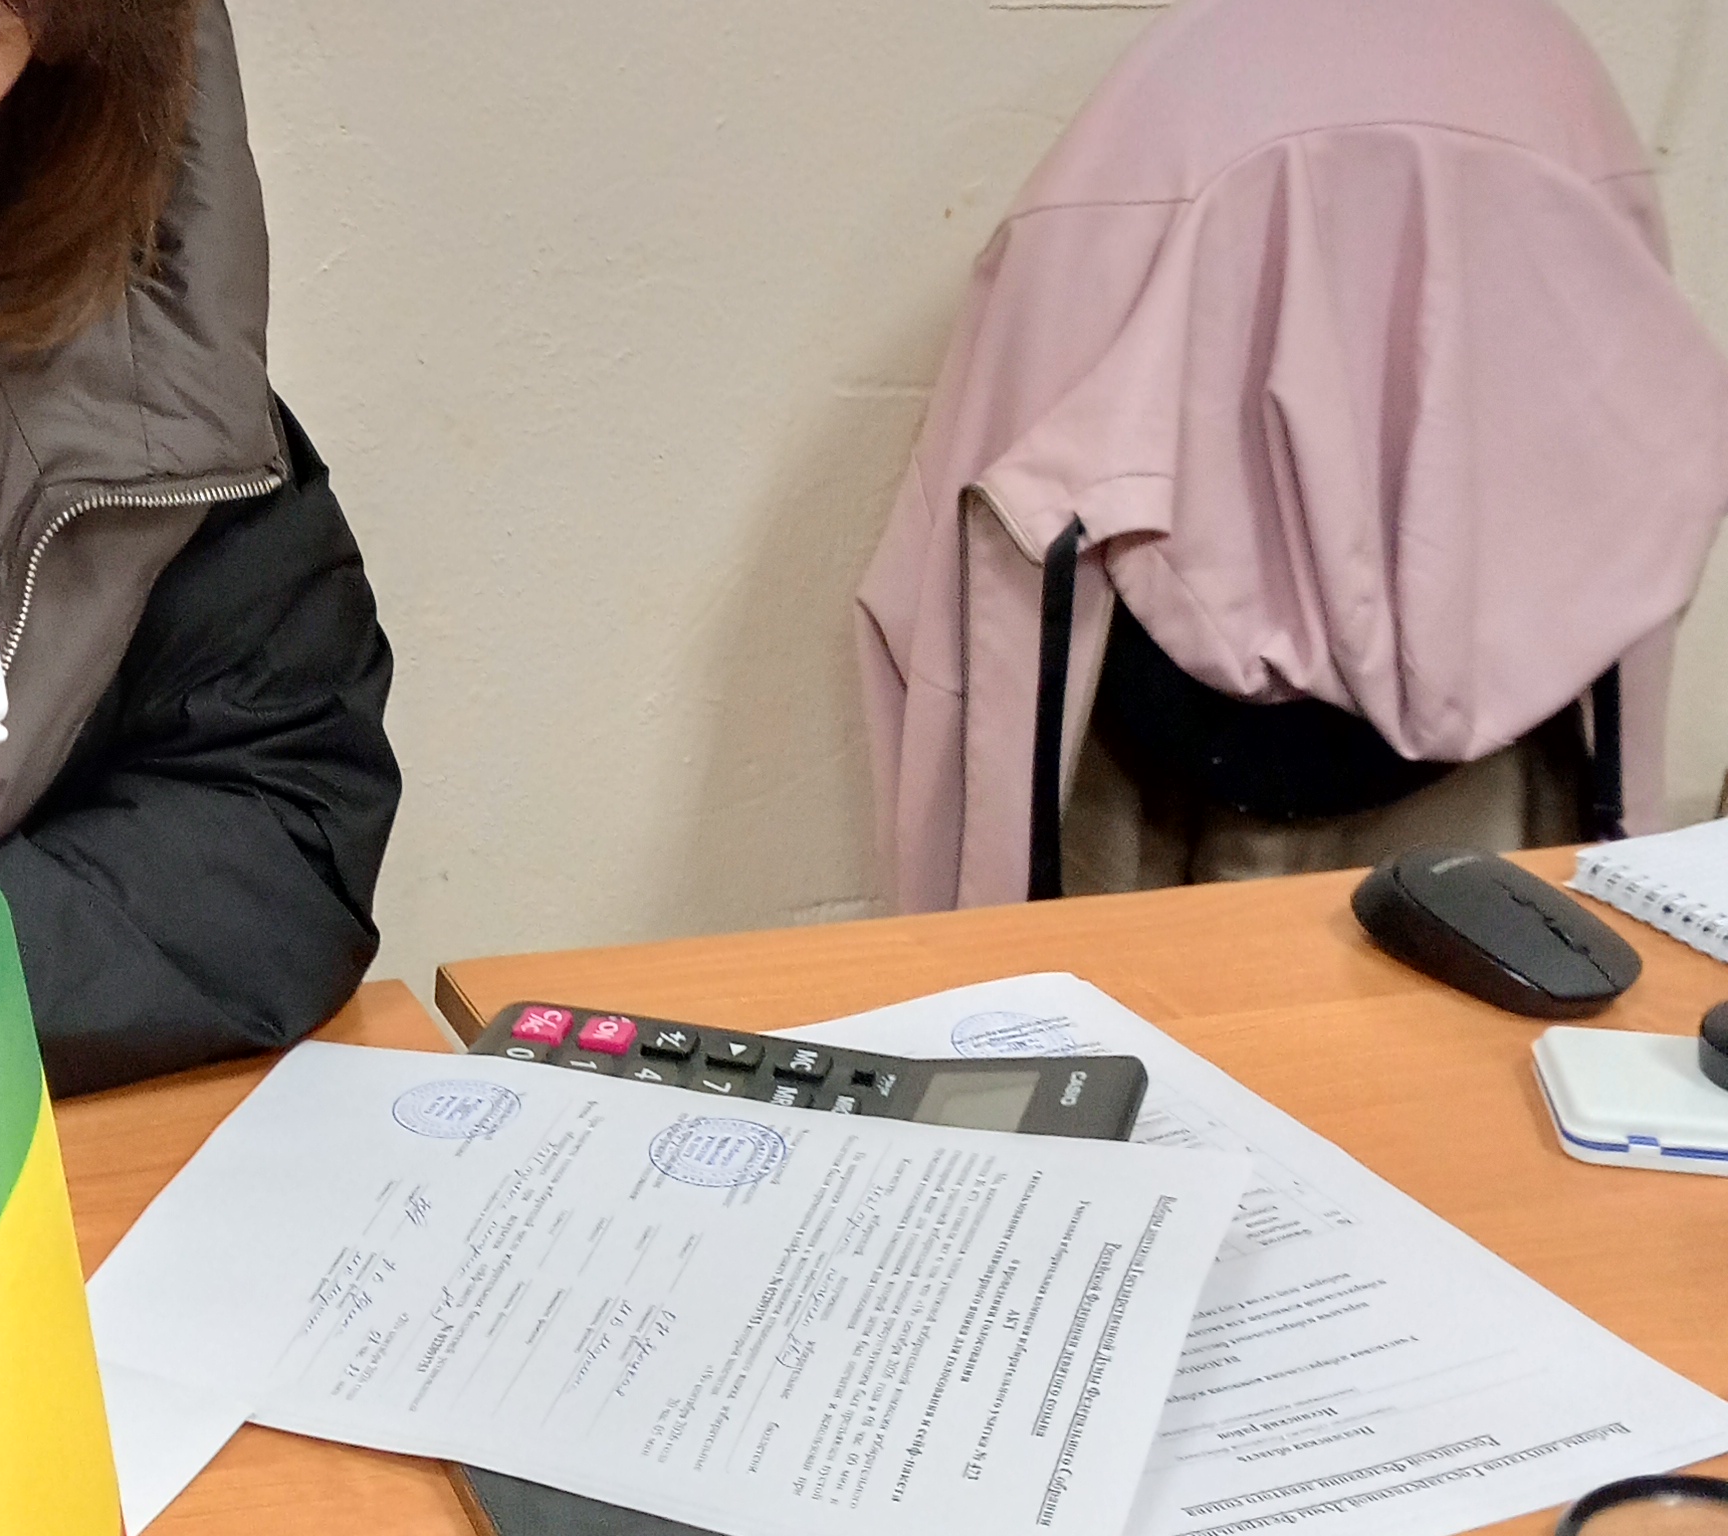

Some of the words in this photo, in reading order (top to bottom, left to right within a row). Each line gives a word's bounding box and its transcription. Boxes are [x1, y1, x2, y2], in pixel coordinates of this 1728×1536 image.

[506, 1046, 535, 1061] 0
[570, 1059, 598, 1070] 1
[789, 1048, 819, 1072] MC
[634, 1067, 662, 1082] 4
[702, 1079, 732, 1094] 7
[1059, 1070, 1088, 1107] CASIO
[1147, 1195, 1177, 1227] Выборы
[1085, 1242, 1121, 1291] Российской
[983, 1265, 1017, 1317] проведении
[957, 1305, 979, 1335] ящика
[1000, 1308, 1021, 1331] АКТ
[1063, 1292, 1100, 1347] Федерации
[1099, 1267, 1144, 1351] Государственной
[948, 1336, 965, 1355] для
[958, 1318, 994, 1383] голосования
[988, 1337, 1030, 1408] избирательного
[1047, 1349, 1076, 1396] девятого
[1085, 1351, 1113, 1384] Думы
[923, 1355, 958, 1417] голосования
[919, 1418, 931, 1426] и
[975, 1409, 1000, 1447] участка
[1033, 1397, 1057, 1437] созыва
[1056, 1386, 1102, 1466] Федерального
[1213, 1423, 1261, 1440] район
[1289, 1425, 1376, 1451] Пензенская
[1402, 1435, 1502, 1467] Российской
[1558, 1423, 1632, 1449] Выборы
[886, 1427, 929, 1503] сейф-пакета
[1233, 1446, 1295, 1463] область
[1478, 1442, 1561, 1471] депутатов
[964, 1462, 983, 1481] 473
[1314, 1462, 1410, 1488] Федерации
[1341, 1466, 1486, 1507] Государственной
[1035, 1467, 1073, 1526] Собрания
[1182, 1498, 1245, 1518] созыва
[1244, 1483, 1318, 1504] девятого
[1293, 1500, 1352, 1519] Думы
